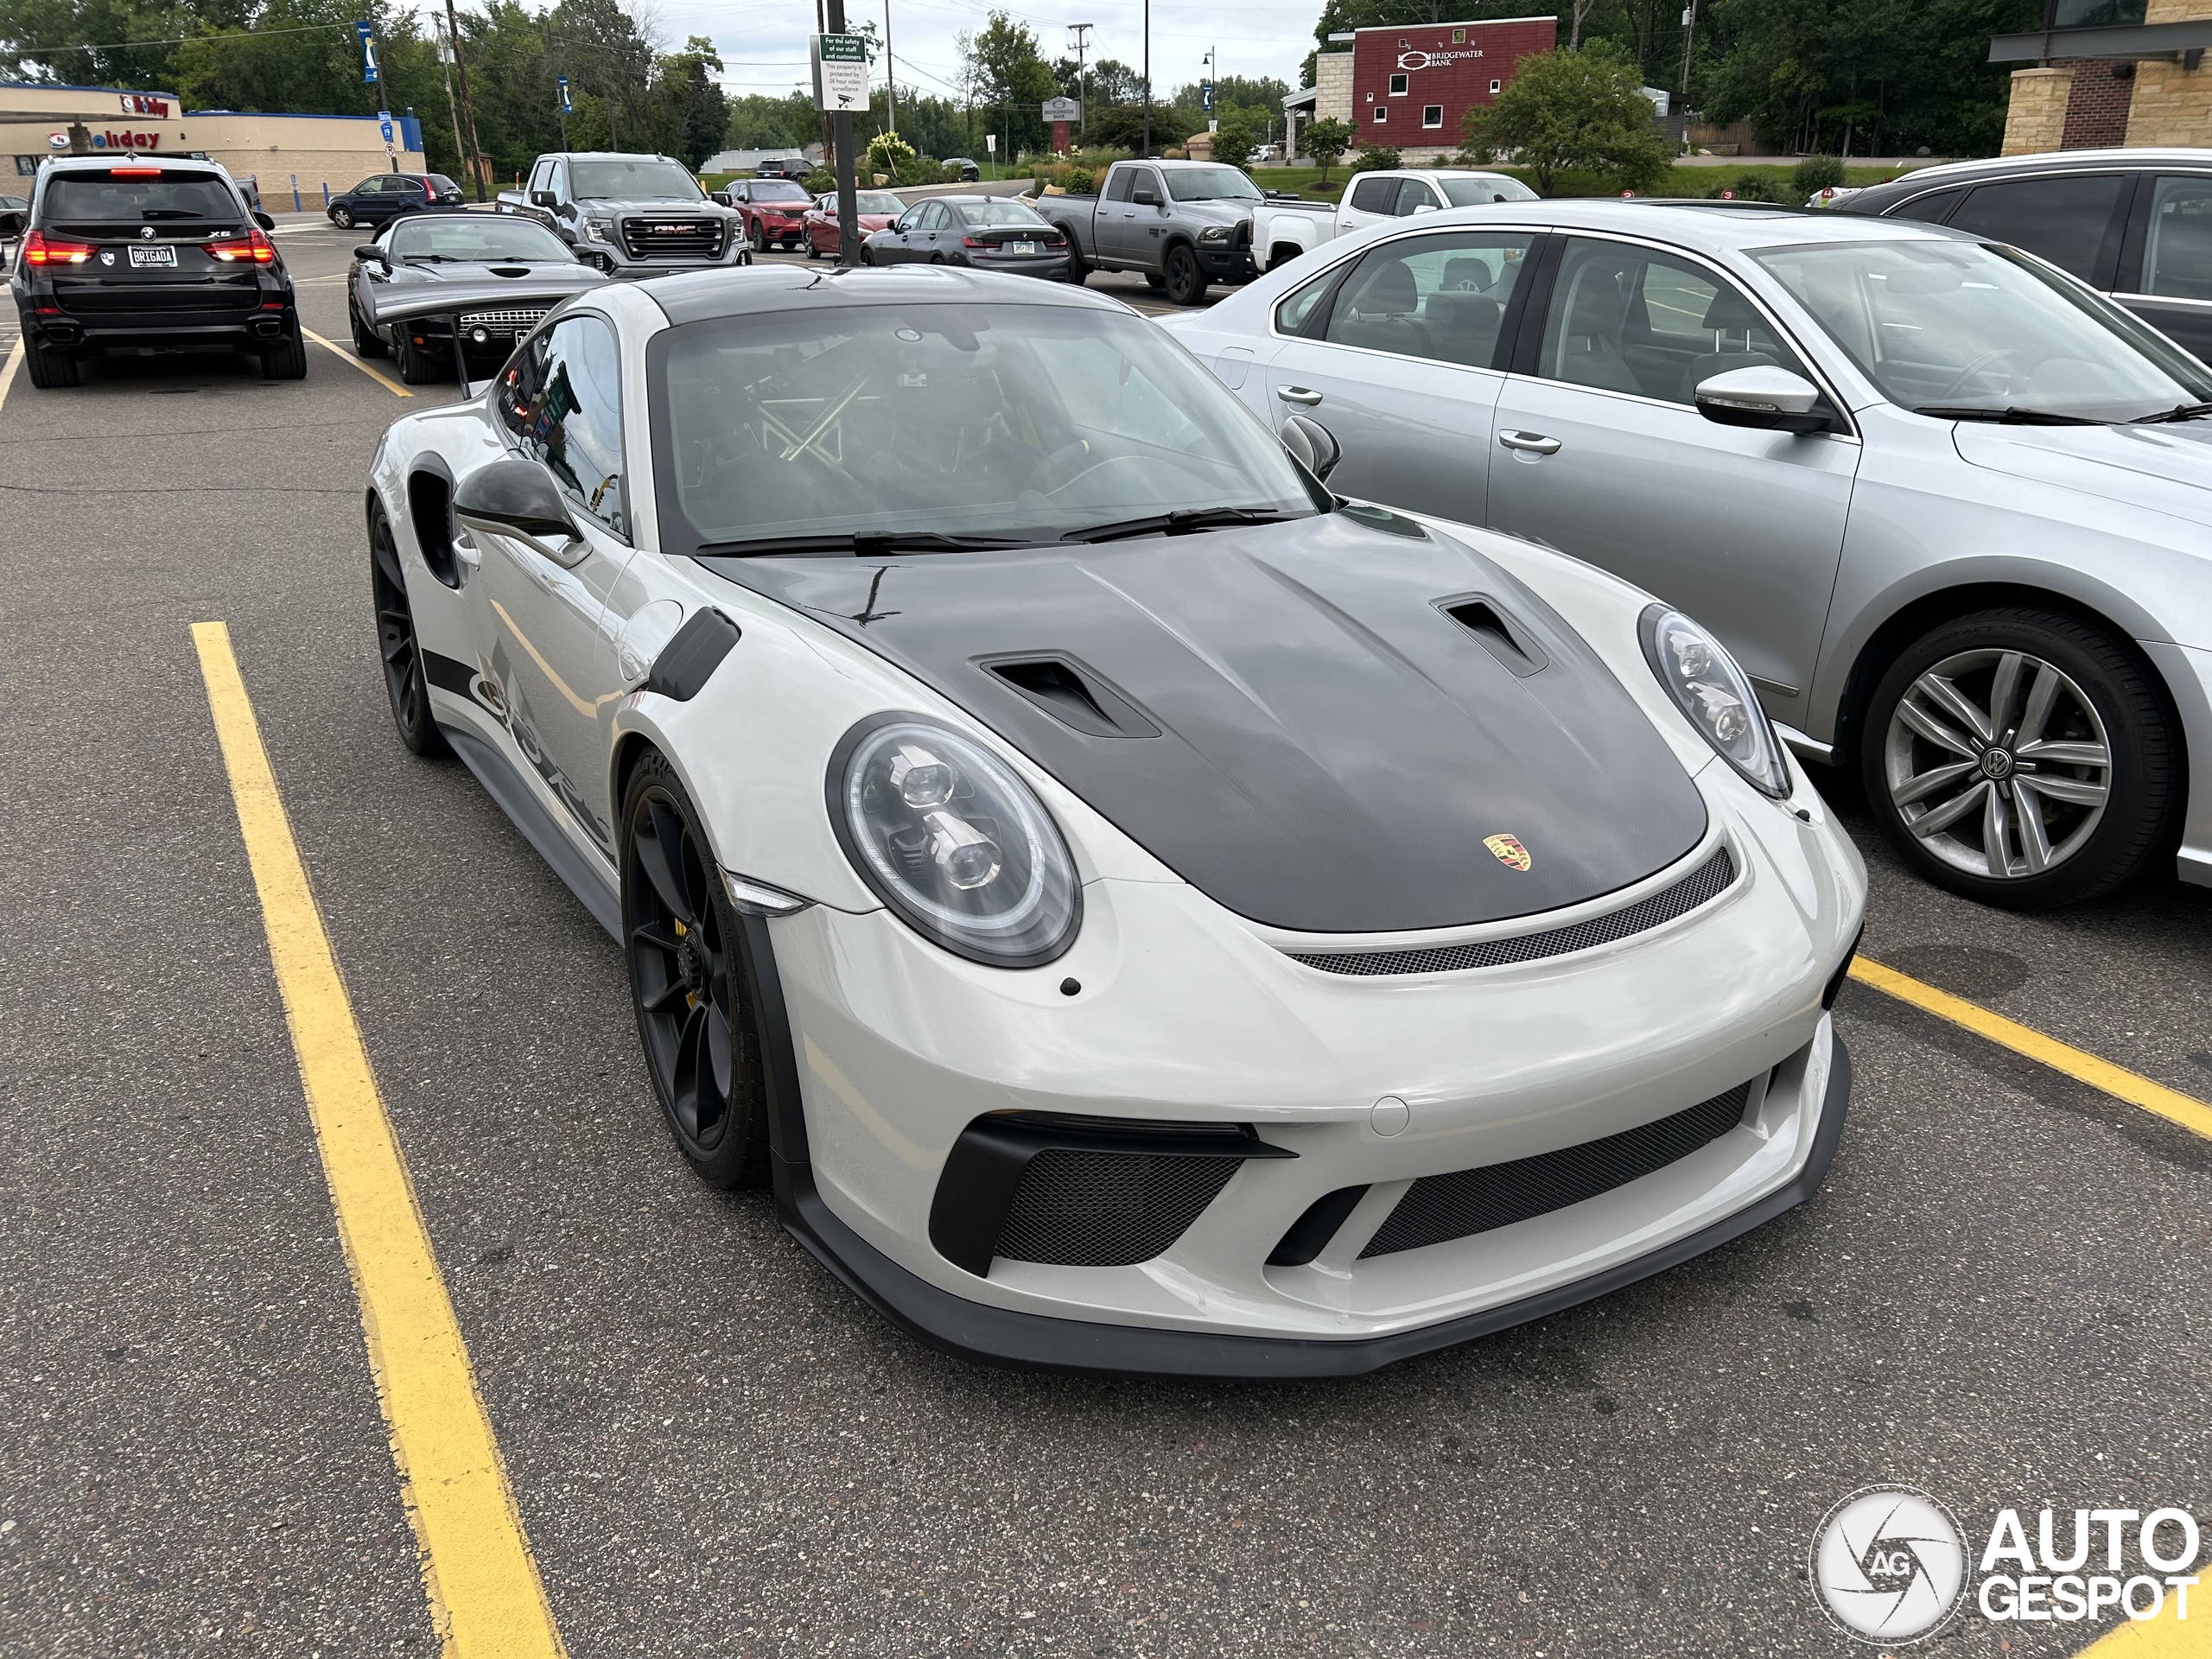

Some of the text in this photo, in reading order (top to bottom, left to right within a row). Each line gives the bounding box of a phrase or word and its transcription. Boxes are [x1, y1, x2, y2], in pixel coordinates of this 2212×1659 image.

[1432, 50, 1484, 59] BRIDGEWATER
[384, 128, 391, 137] 19
[87, 130, 159, 149] oliday
[654, 226, 696, 234] GMC
[134, 251, 172, 263] BRIGADA
